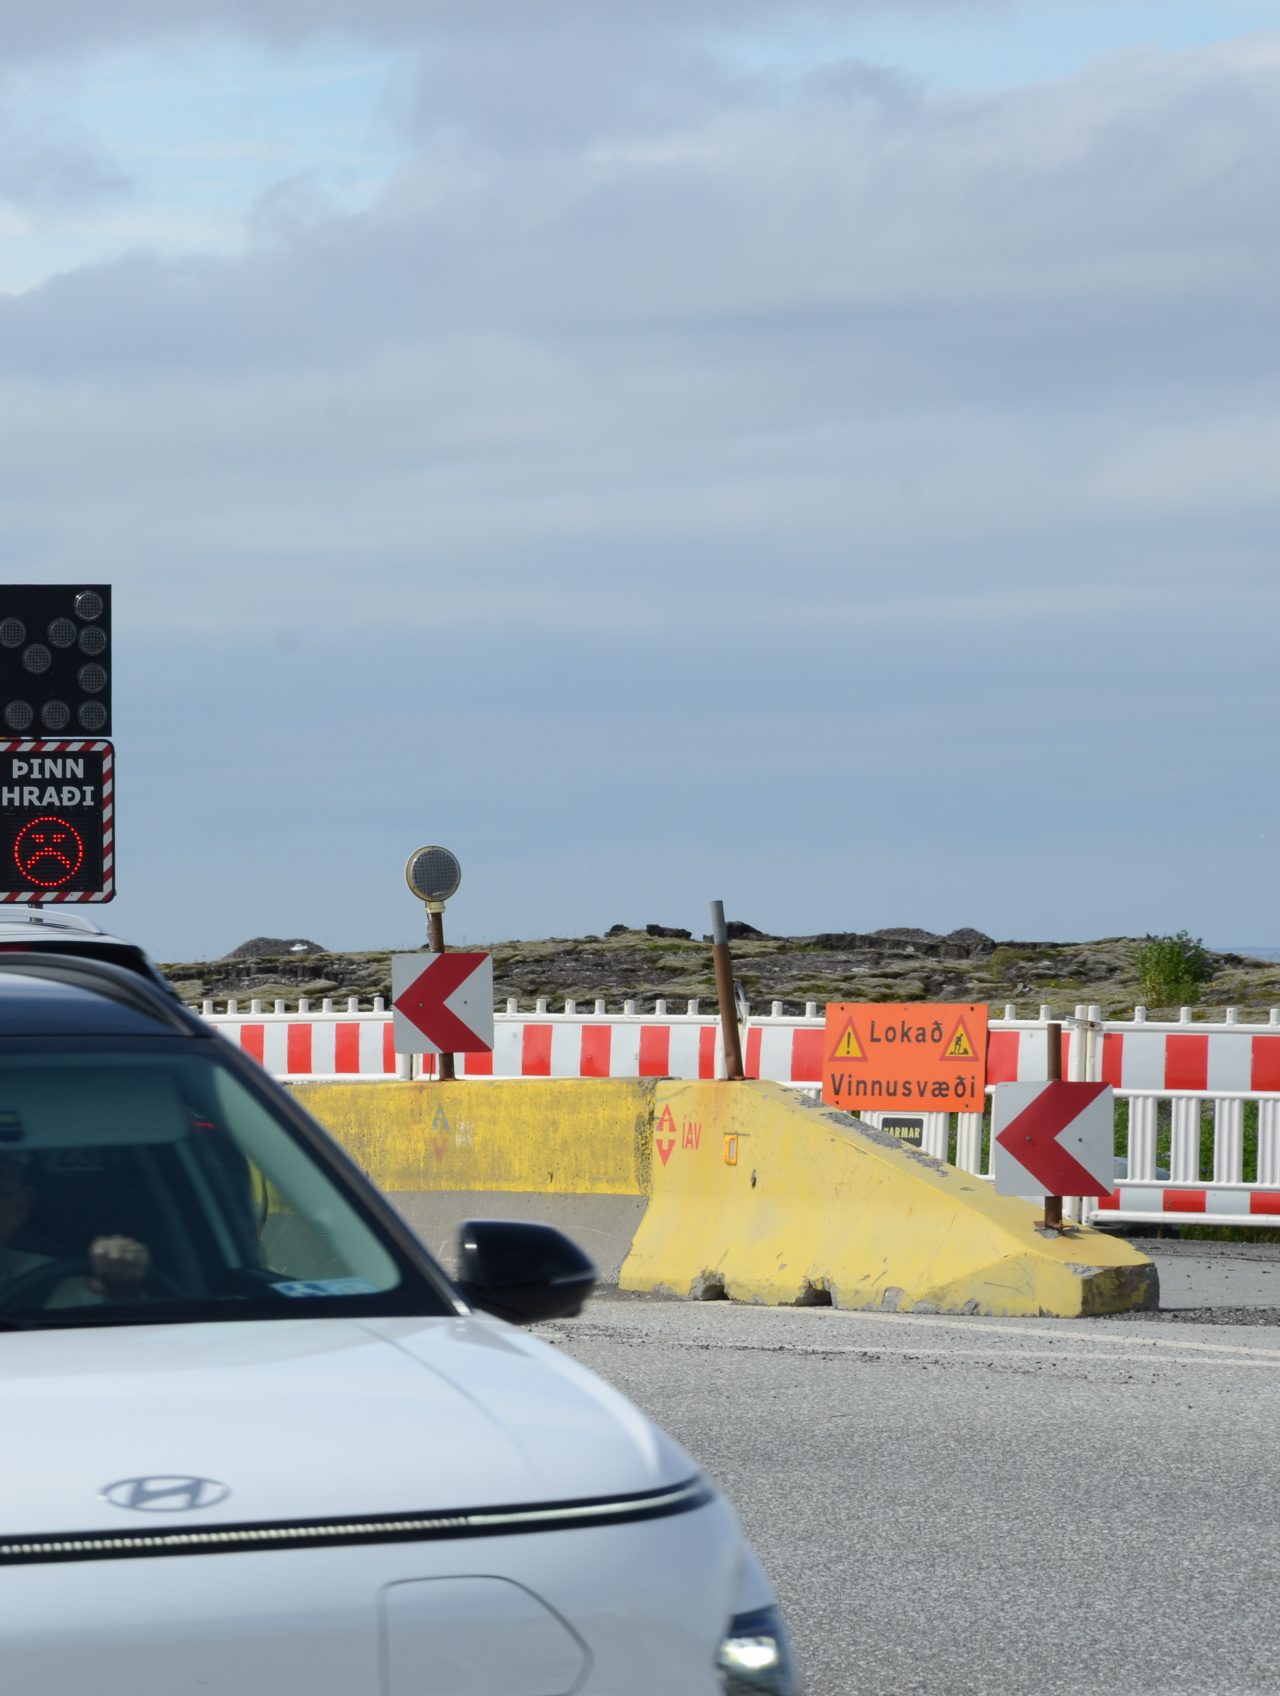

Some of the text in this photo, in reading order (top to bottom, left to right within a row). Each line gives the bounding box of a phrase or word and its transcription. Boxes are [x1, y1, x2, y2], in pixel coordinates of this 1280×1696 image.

[12, 758, 84, 779] ÞINN
[1, 786, 95, 807] HRAÐI
[870, 1020, 943, 1043] Lokað
[831, 1073, 976, 1098] Vinnusvæði
